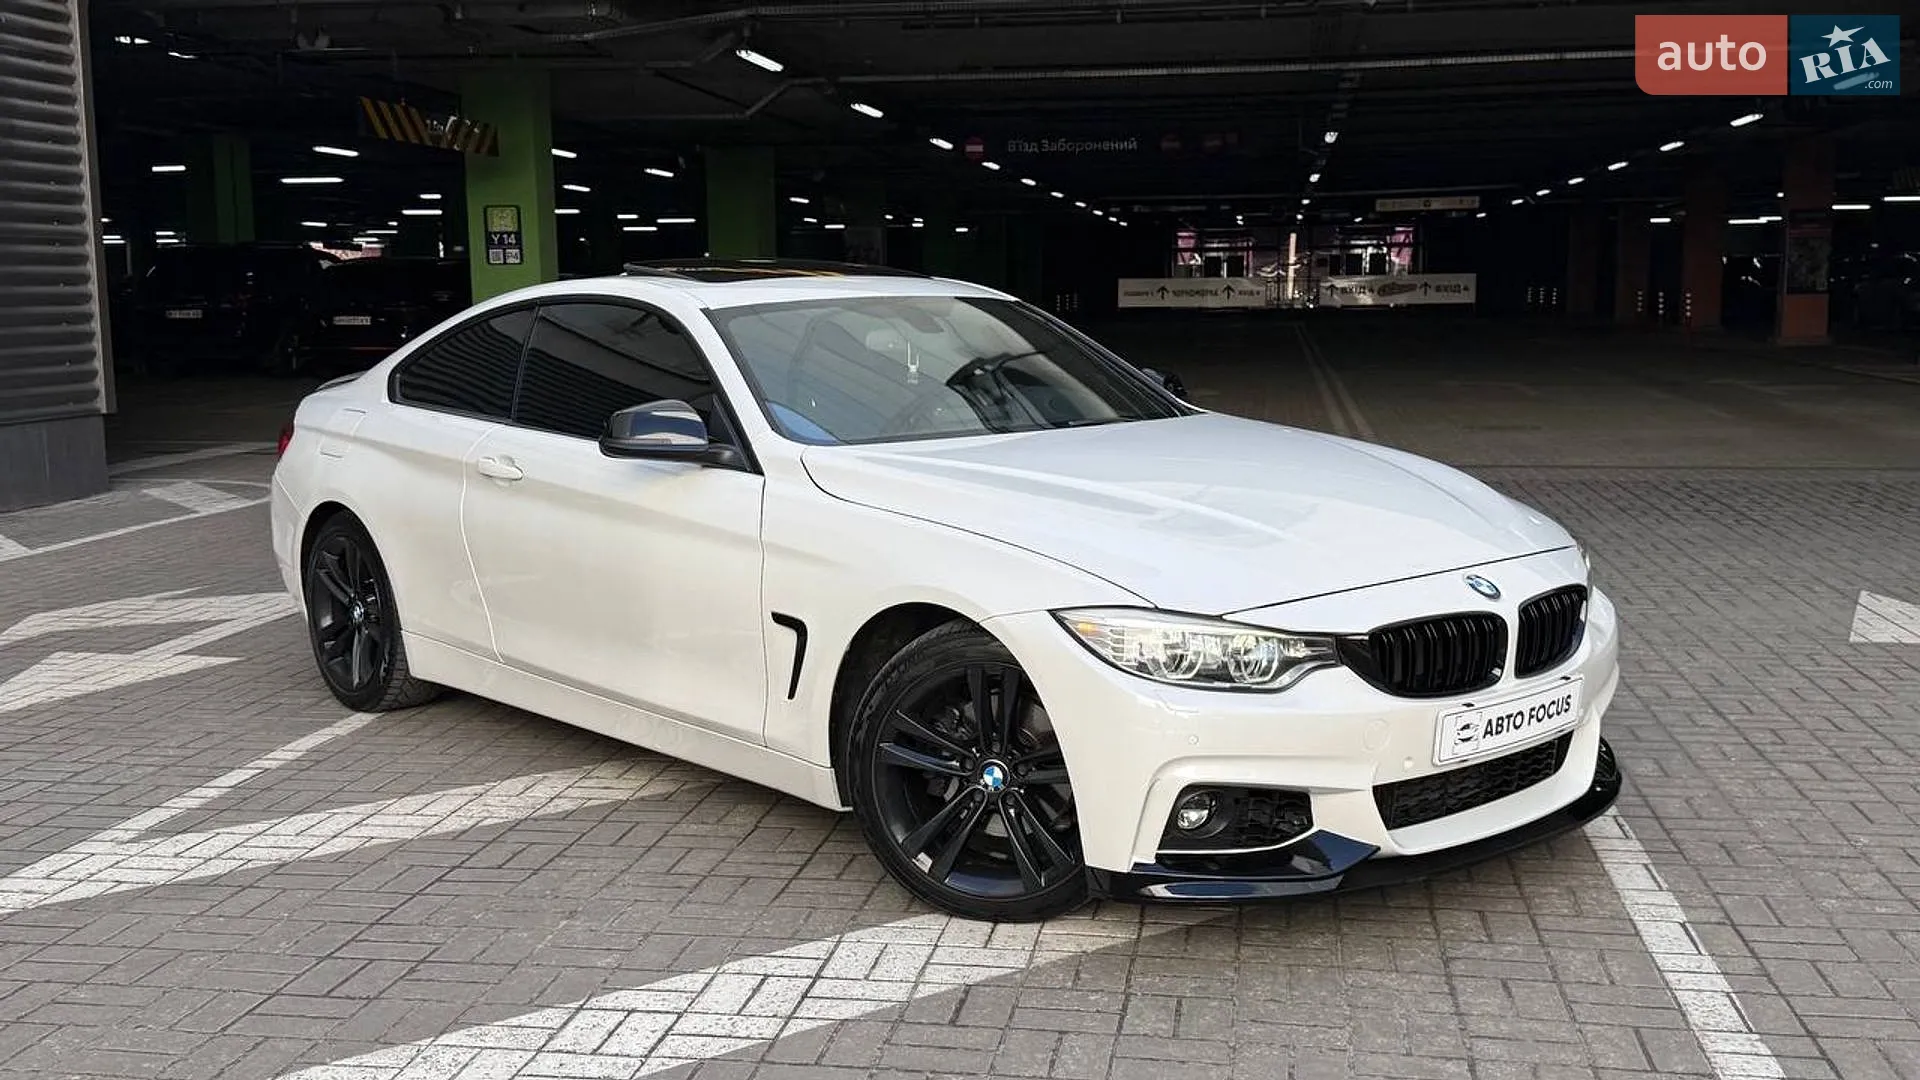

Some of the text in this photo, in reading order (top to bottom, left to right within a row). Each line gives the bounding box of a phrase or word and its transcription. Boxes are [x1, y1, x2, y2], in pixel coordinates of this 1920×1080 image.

[1041, 137, 1138, 155] Заборонений
[491, 233, 517, 245] Y 14
[1527, 694, 1572, 726] FOCUS
